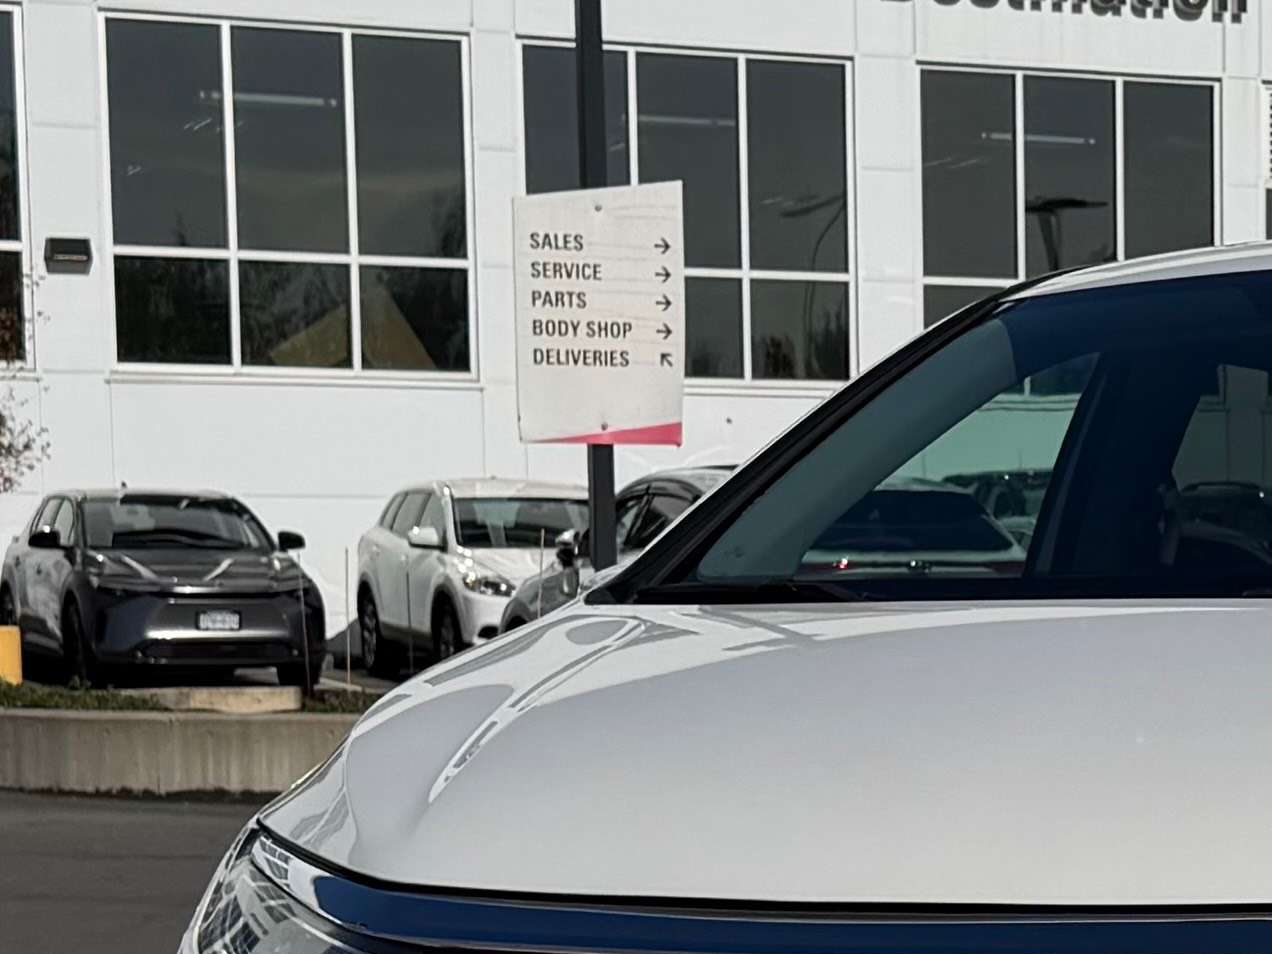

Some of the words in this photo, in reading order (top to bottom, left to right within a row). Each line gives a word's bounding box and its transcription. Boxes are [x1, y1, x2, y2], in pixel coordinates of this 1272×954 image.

[530, 232, 584, 251] SALES
[530, 261, 602, 281] SERVICE
[531, 290, 587, 309] PARTS
[532, 319, 581, 338] BODY
[586, 321, 632, 339] SHOP
[533, 348, 630, 367] DELIVERIES
